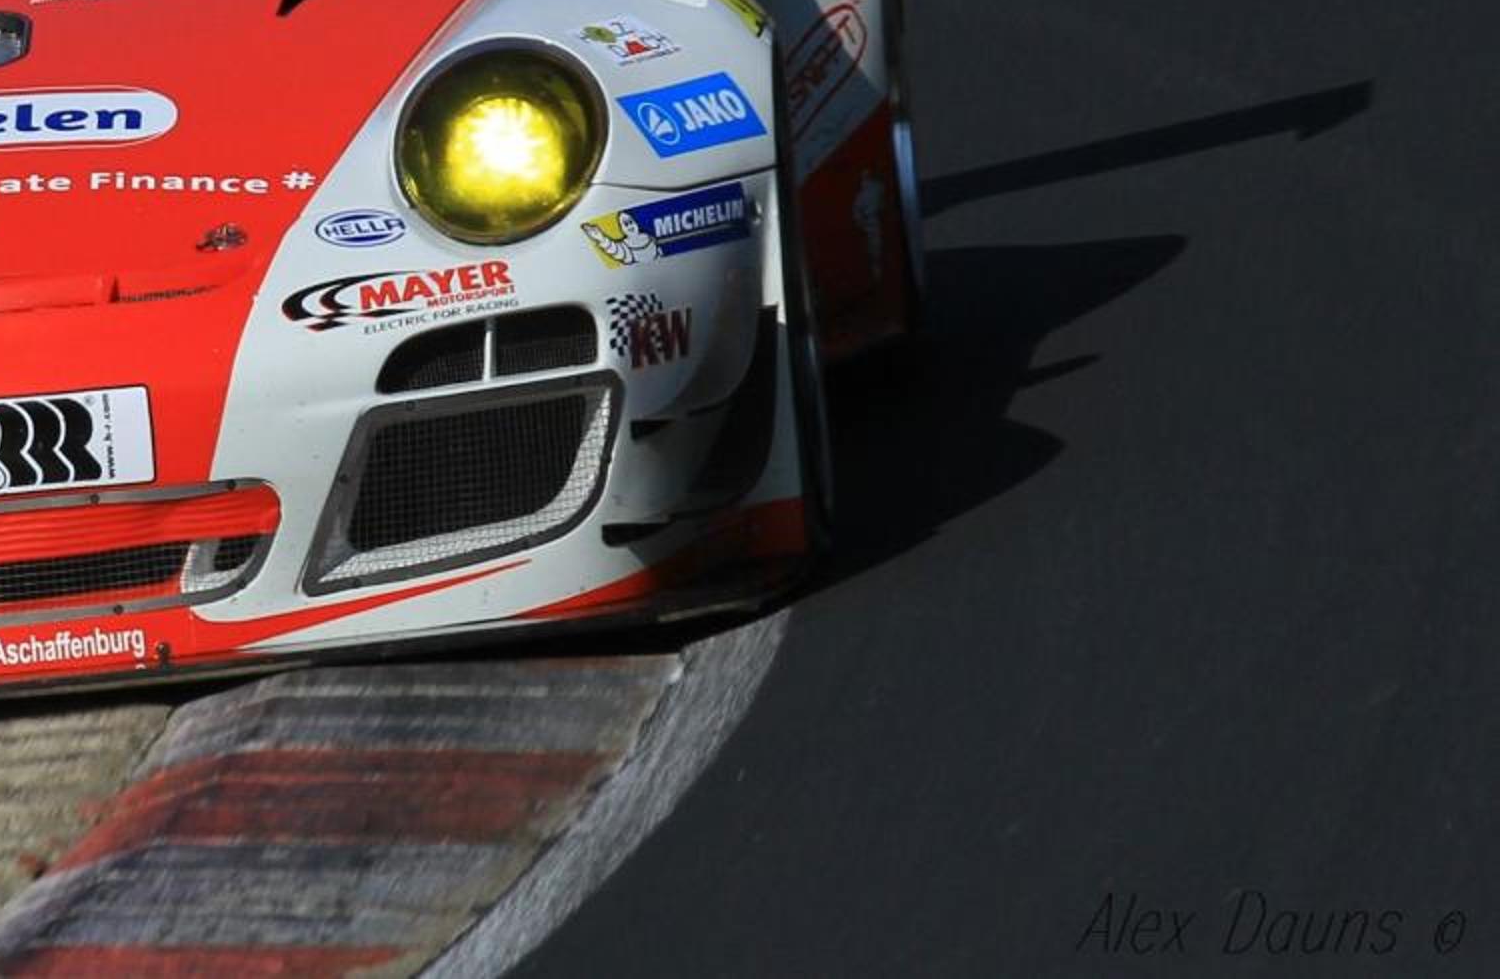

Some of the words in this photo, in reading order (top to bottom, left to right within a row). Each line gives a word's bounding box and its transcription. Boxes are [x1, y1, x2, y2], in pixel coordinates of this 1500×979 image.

[674, 90, 746, 133] JAKO
[90, 172, 269, 193] Finance
[322, 218, 407, 238] HELLA
[653, 198, 744, 238] MICHELIN
[359, 260, 512, 311] MAYER
[427, 285, 516, 308] MOTORSPORT
[364, 314, 427, 335] ELECTRIC
[432, 308, 463, 320] FOR
[465, 299, 520, 314] RACING
[629, 306, 692, 369] KW
